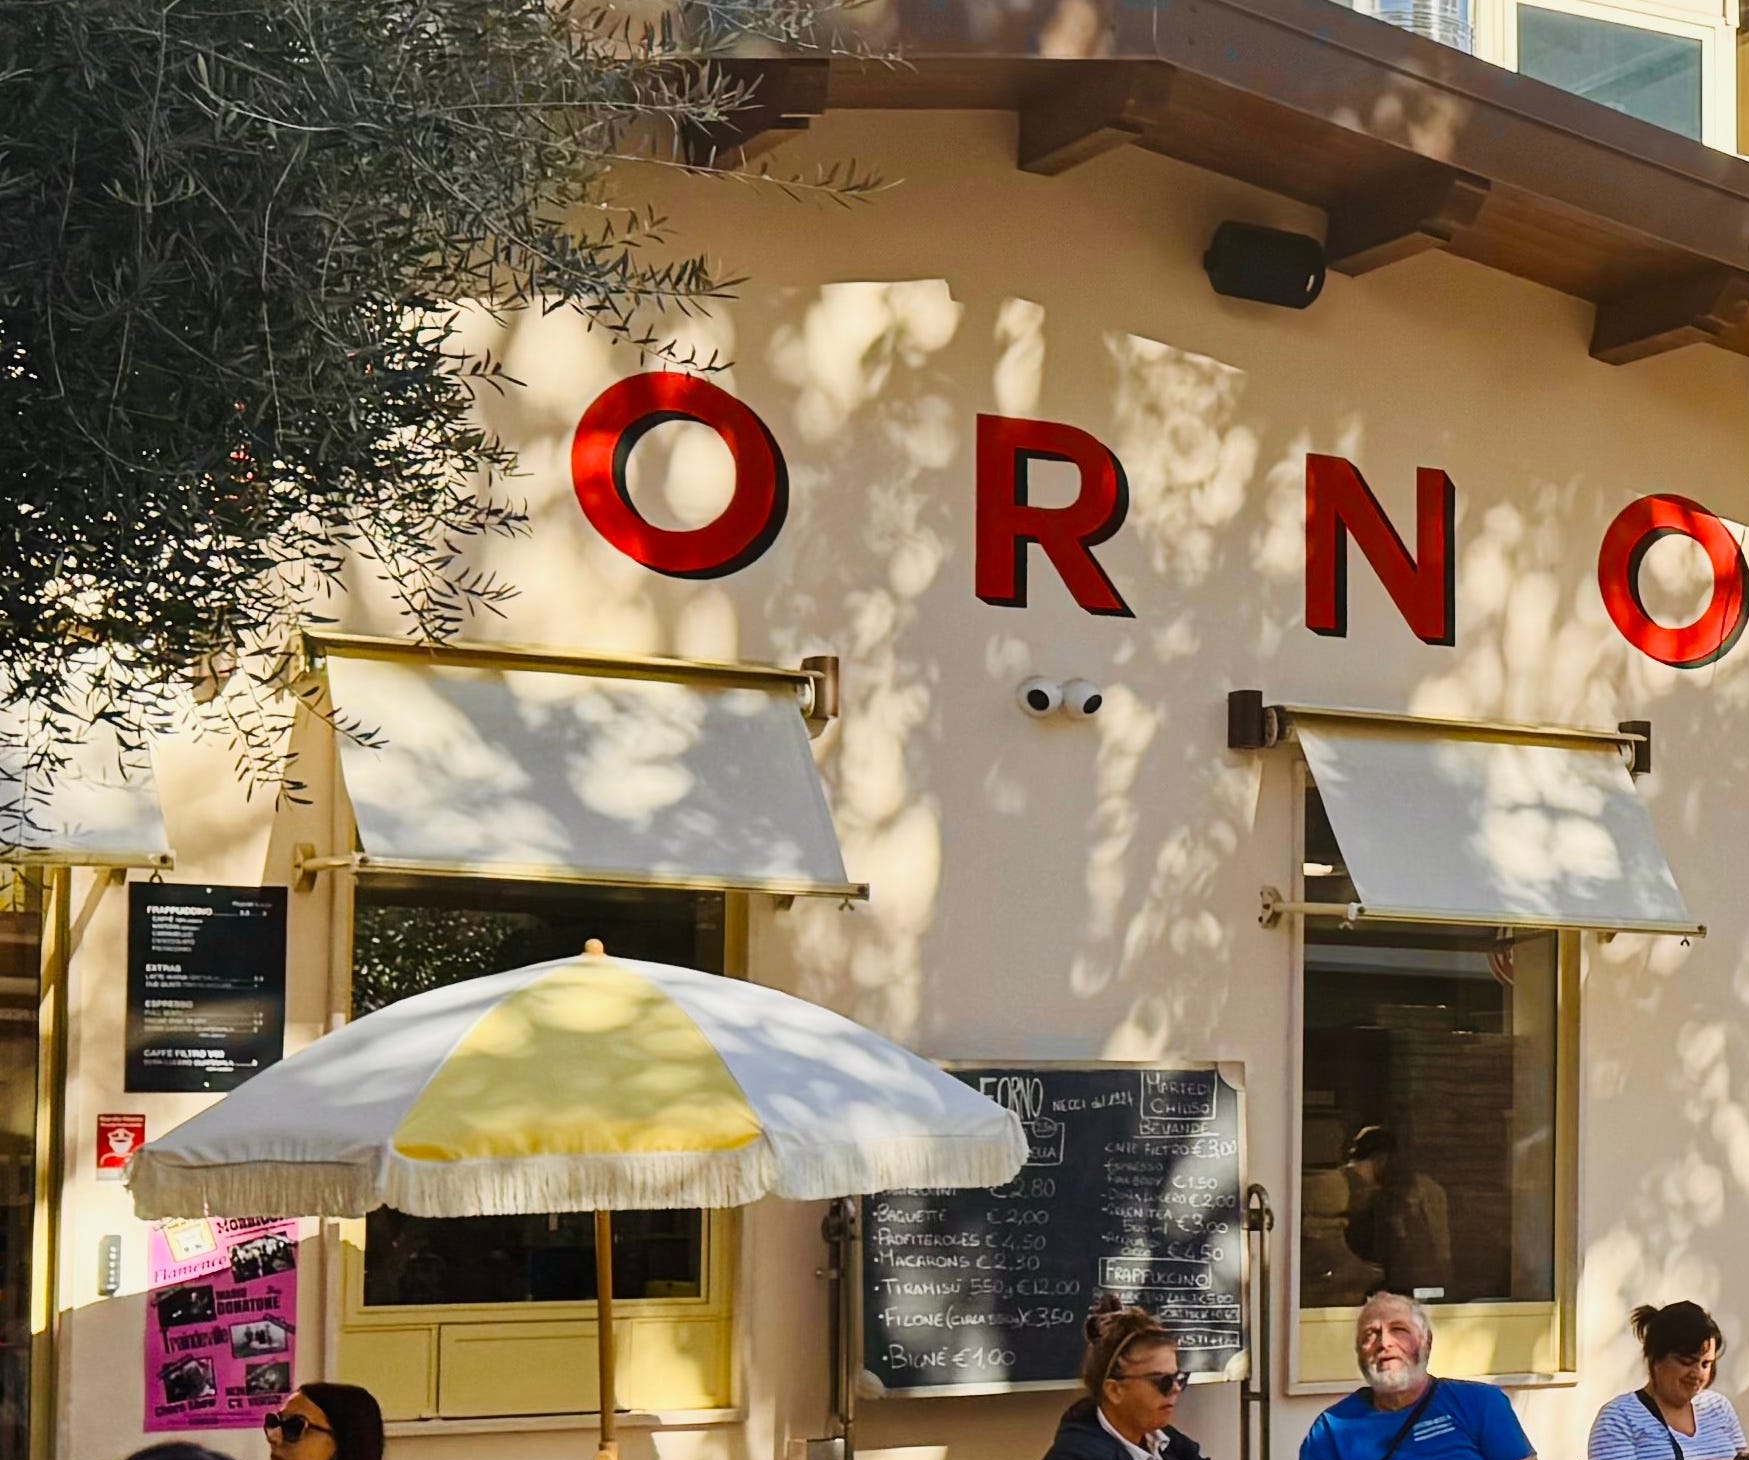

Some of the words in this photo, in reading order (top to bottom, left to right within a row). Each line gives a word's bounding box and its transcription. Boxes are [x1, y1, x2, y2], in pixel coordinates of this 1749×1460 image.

[1139, 1118, 1209, 1136] BEVANDE
[876, 1202, 948, 1224] BAGUETTE
[877, 1226, 981, 1247] PROFITEROLES
[879, 1248, 971, 1269] MACARONS
[1105, 1259, 1209, 1287] FRAPPUCCINO
[883, 1305, 943, 1328] FILONE
